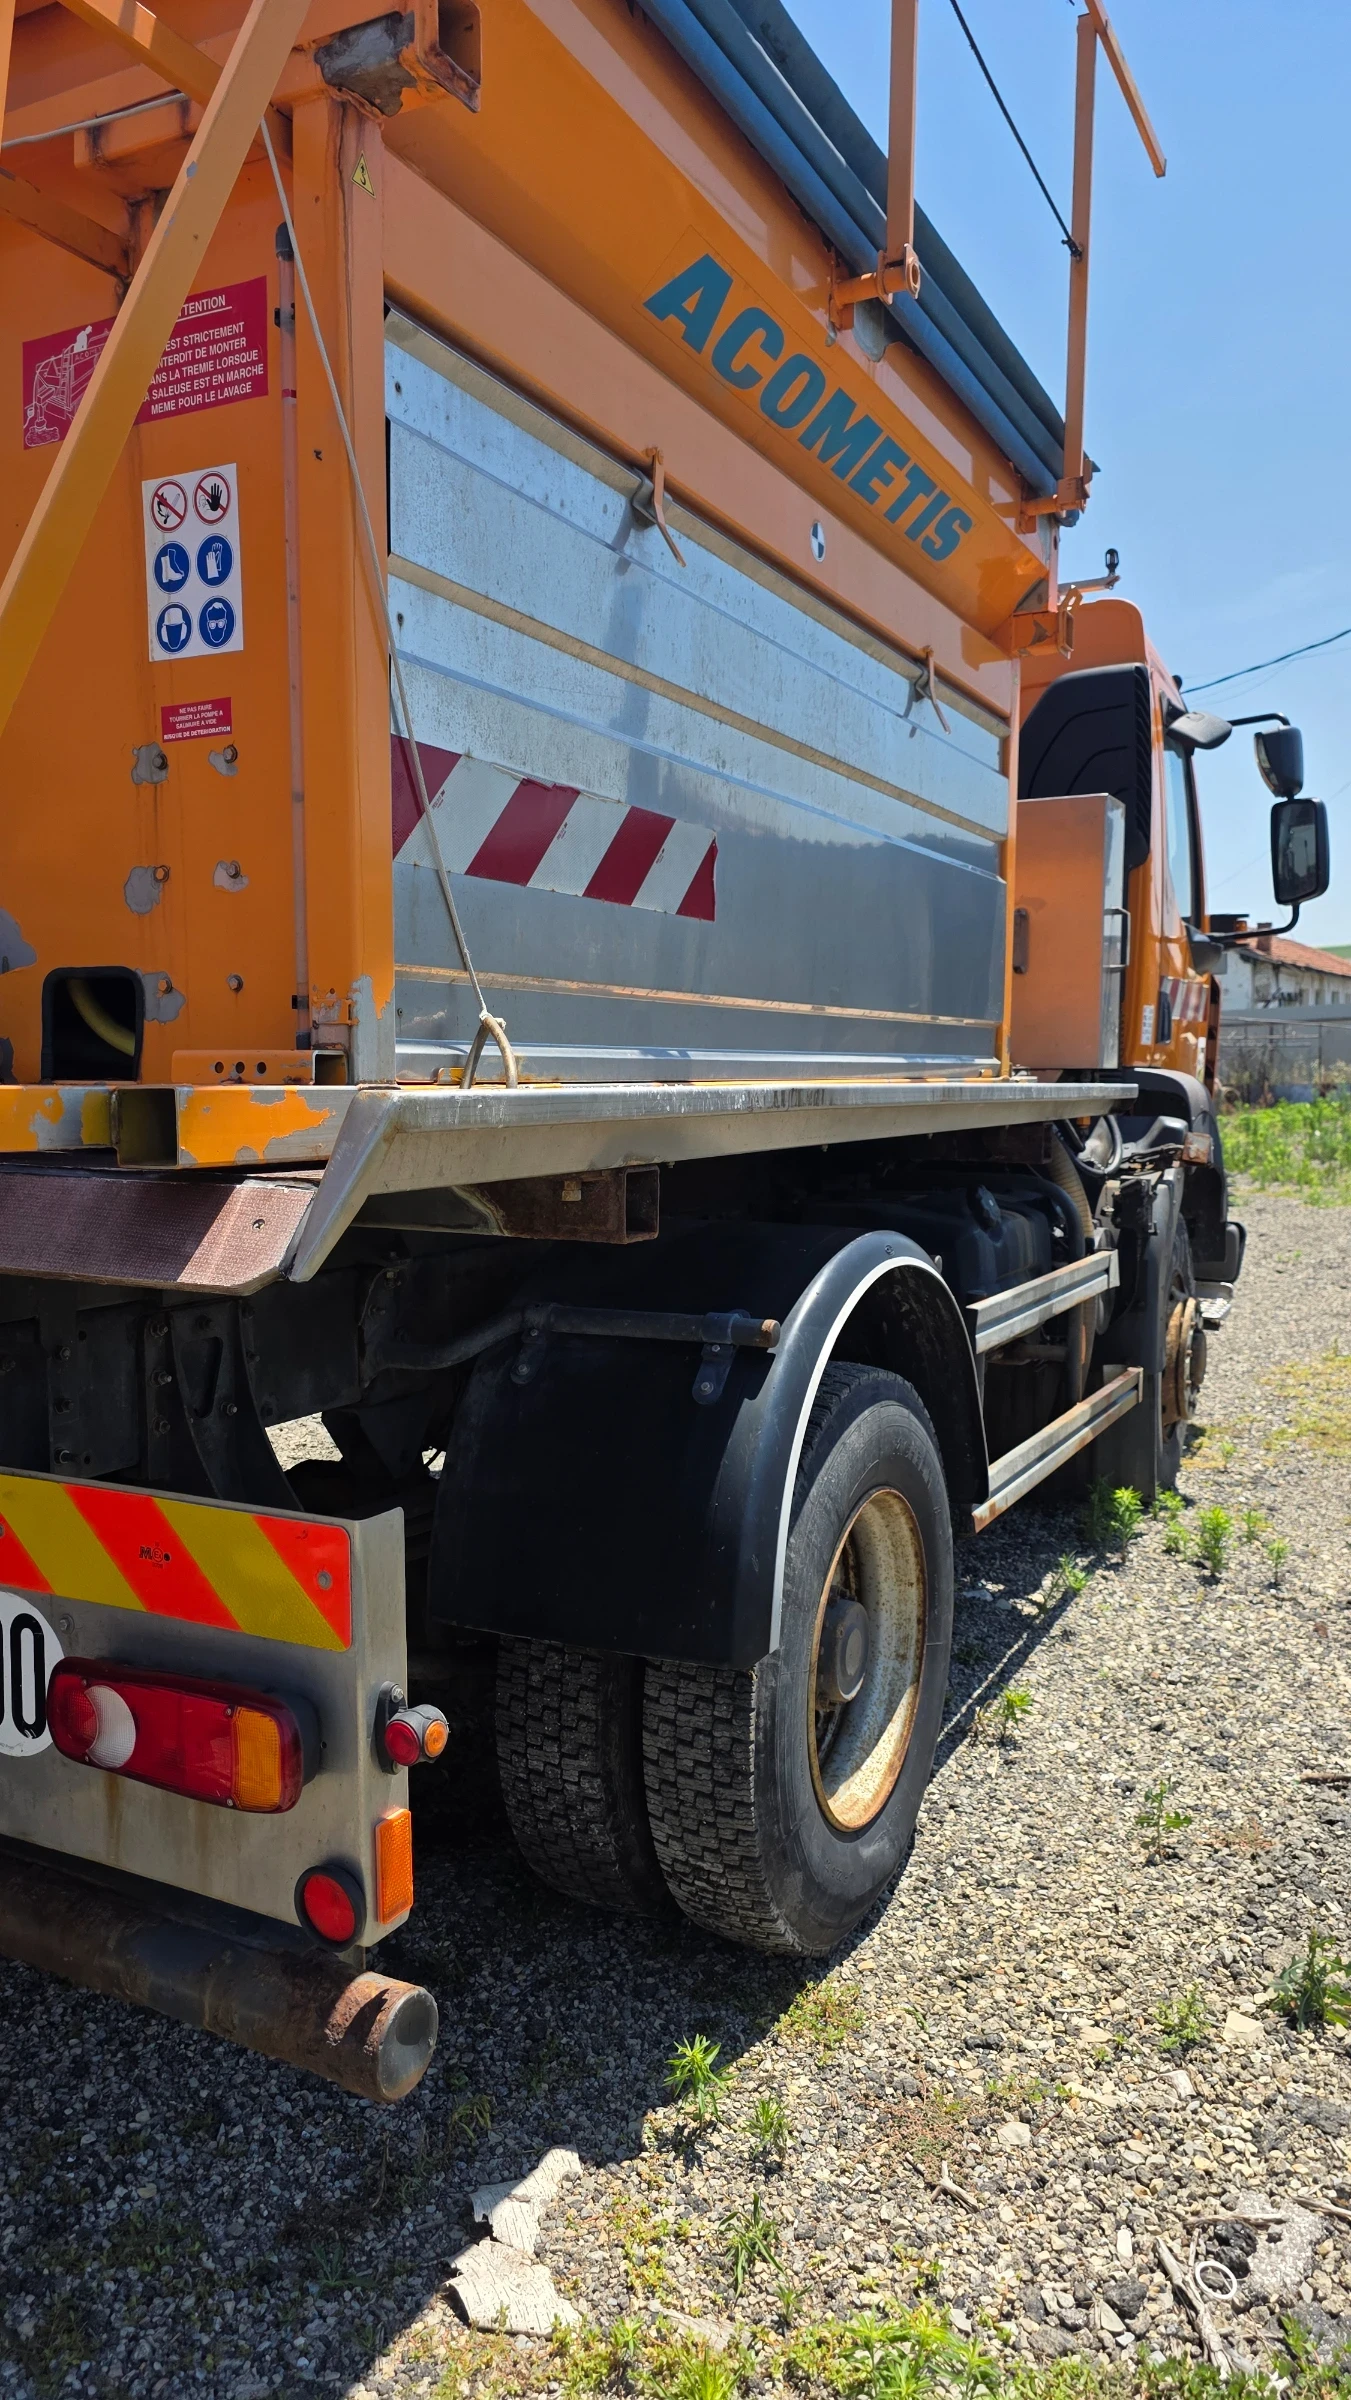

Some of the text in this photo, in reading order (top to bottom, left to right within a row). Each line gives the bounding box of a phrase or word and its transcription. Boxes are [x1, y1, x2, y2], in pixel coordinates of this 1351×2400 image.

[178, 295, 226, 317] TENTION
[157, 337, 247, 369] NTERDIT DE MONTER
[166, 321, 245, 351] EST STRICTEMENT
[150, 349, 259, 385] ANS LA TREMIE LORSQUE
[152, 382, 192, 400] SALEUSE
[193, 376, 211, 390] EST
[212, 373, 225, 386] EN
[226, 363, 264, 384] MARCHE
[151, 382, 252, 415] MEME POUR LE LAVAGE
[643, 253, 973, 561] ACOMETIS
[0, 1613, 47, 1739] 0
